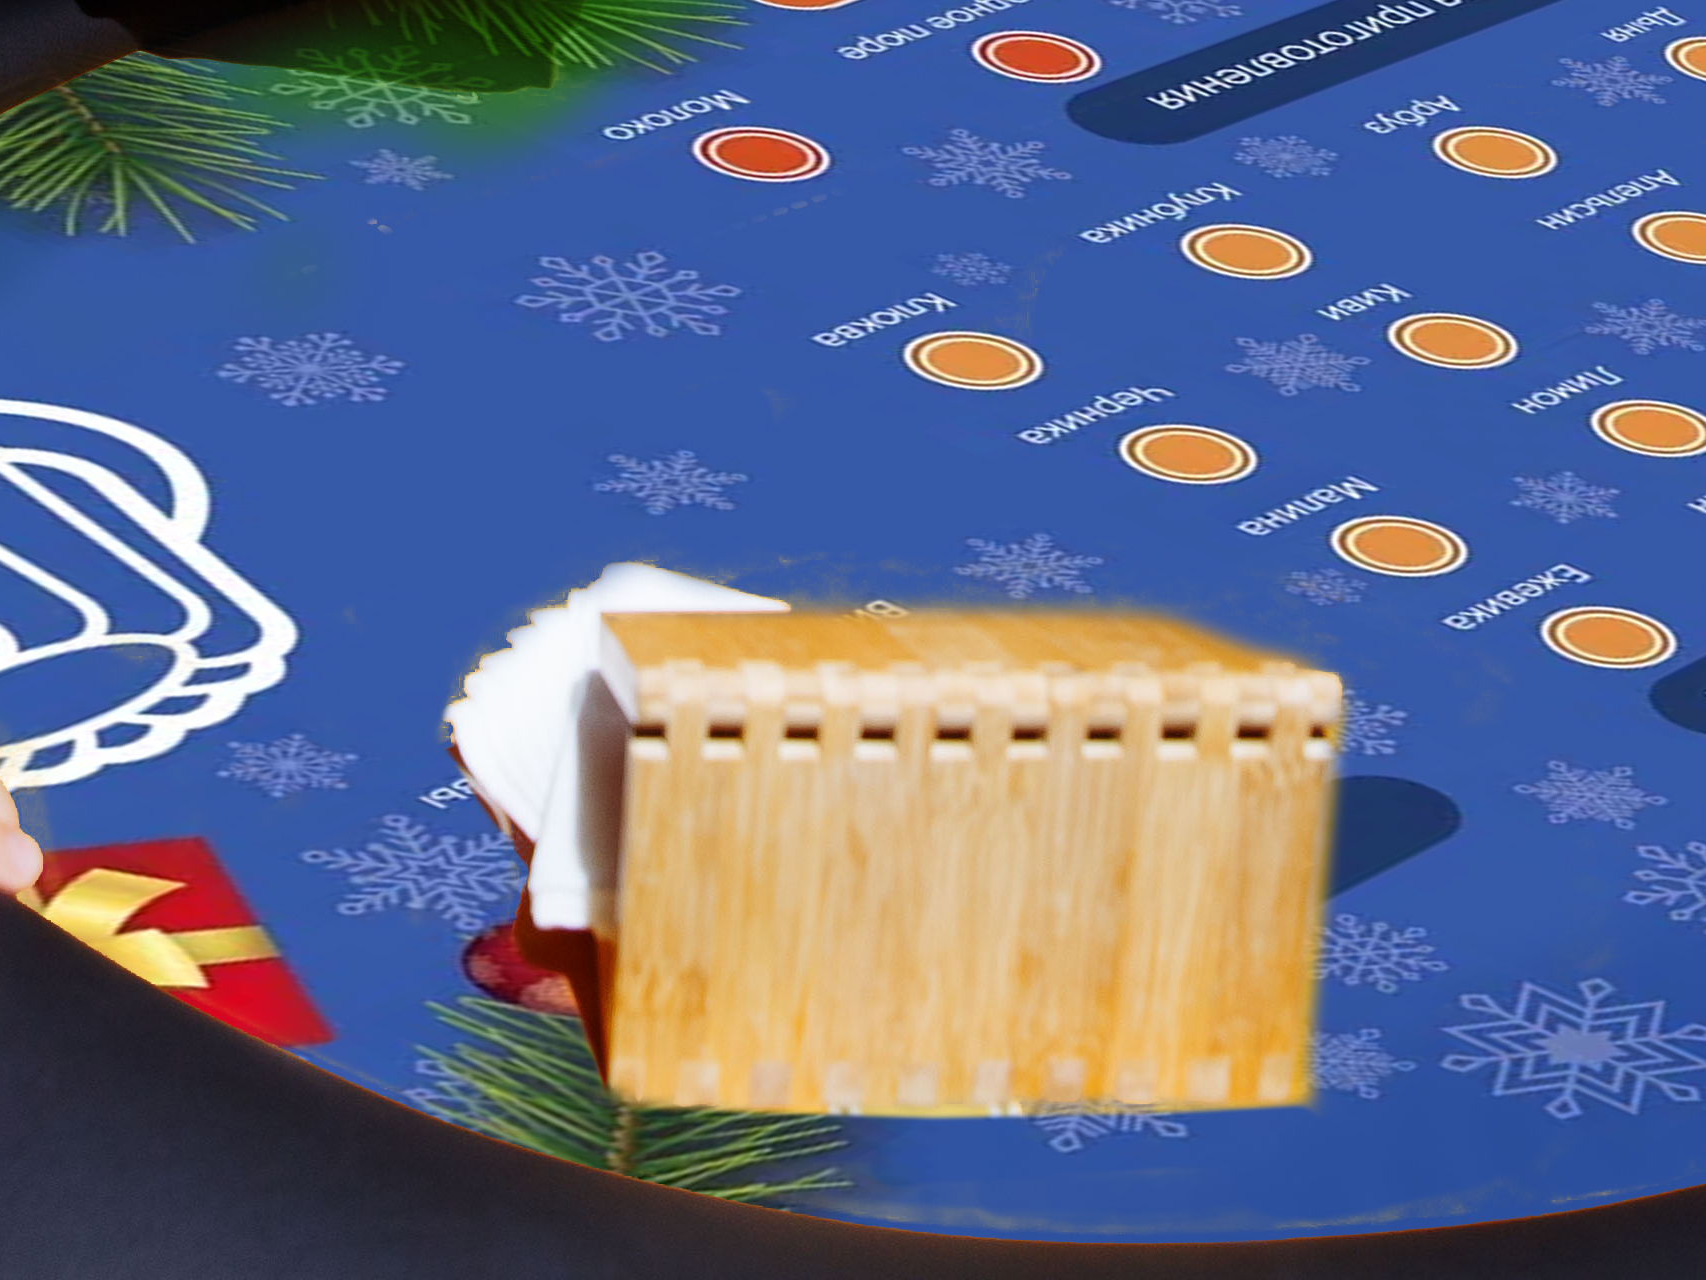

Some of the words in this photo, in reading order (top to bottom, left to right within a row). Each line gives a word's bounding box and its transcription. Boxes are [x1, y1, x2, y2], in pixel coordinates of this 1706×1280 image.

[837, 23, 931, 62] пюре
[1601, 6, 1686, 43] Дыня
[1146, 0, 1436, 110] приготовления
[603, 89, 750, 140] Молоко
[1364, 95, 1461, 134] Арбуз
[1080, 182, 1242, 244] Клубника
[1536, 169, 1680, 230] Апельсин
[812, 292, 957, 347] Клюква
[1317, 283, 1411, 321] Киви
[1018, 387, 1175, 445] Черника
[1511, 365, 1623, 414] Лимон
[1237, 476, 1379, 536] Малина
[1442, 564, 1591, 630] Ежевика
